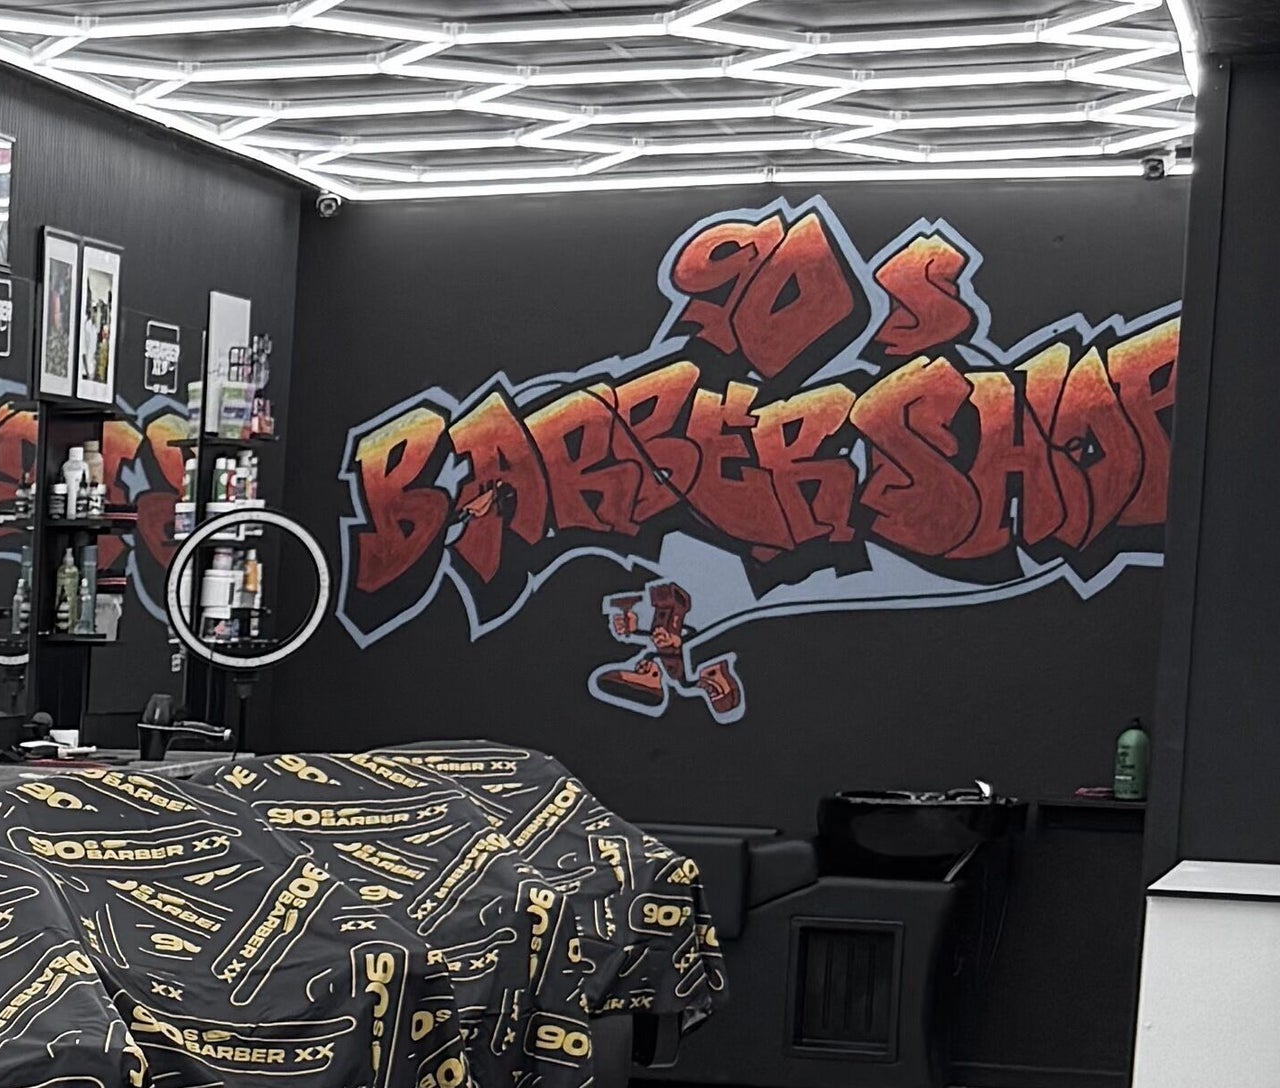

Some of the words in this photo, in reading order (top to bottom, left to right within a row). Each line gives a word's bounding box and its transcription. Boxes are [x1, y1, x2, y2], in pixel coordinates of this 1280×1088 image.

[86, 844, 185, 861] BARBER
[151, 981, 185, 1002] XX
[182, 1040, 286, 1064] BARBER
[293, 1042, 335, 1064] XX
